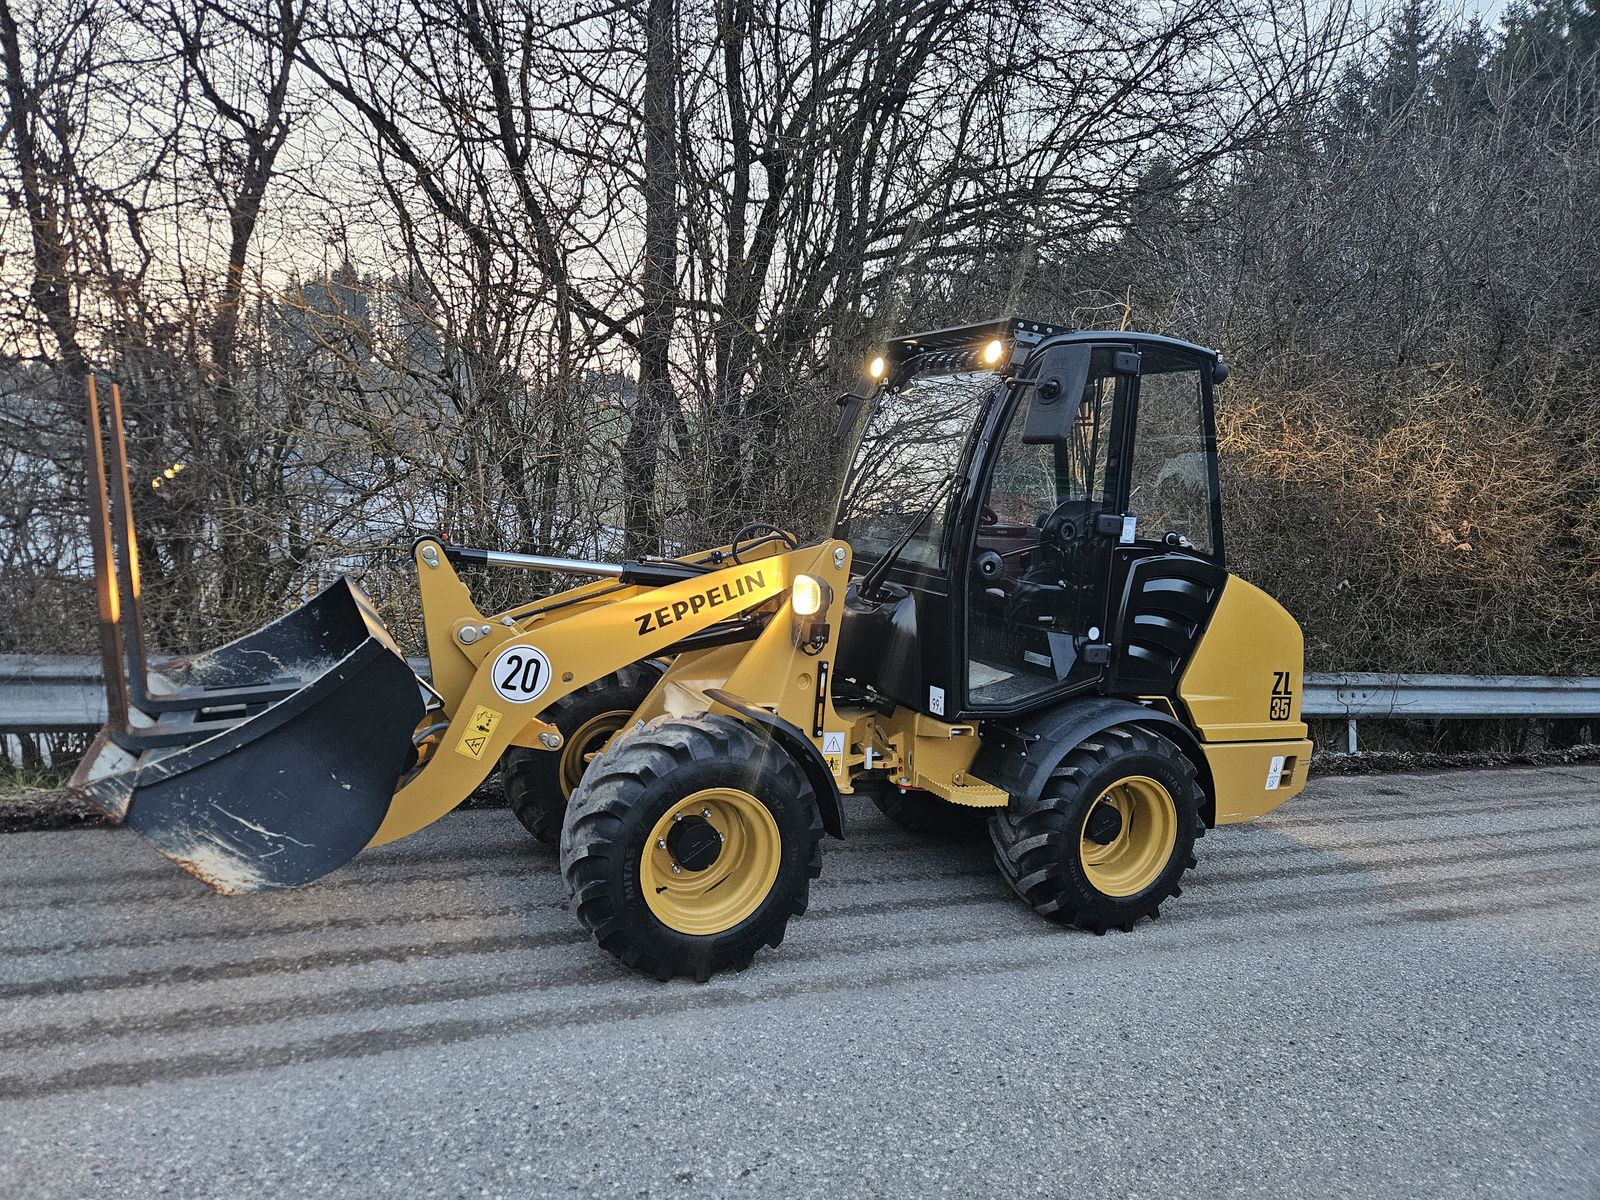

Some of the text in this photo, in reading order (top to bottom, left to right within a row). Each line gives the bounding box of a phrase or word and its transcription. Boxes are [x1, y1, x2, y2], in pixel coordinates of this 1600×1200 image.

[634, 570, 766, 636] ZEPPELIN
[501, 655, 541, 693] 20
[1271, 671, 1292, 696] ZL
[1271, 698, 1290, 719] 35
[1159, 767, 1183, 796] MITAS
[623, 847, 636, 900] MITAS
